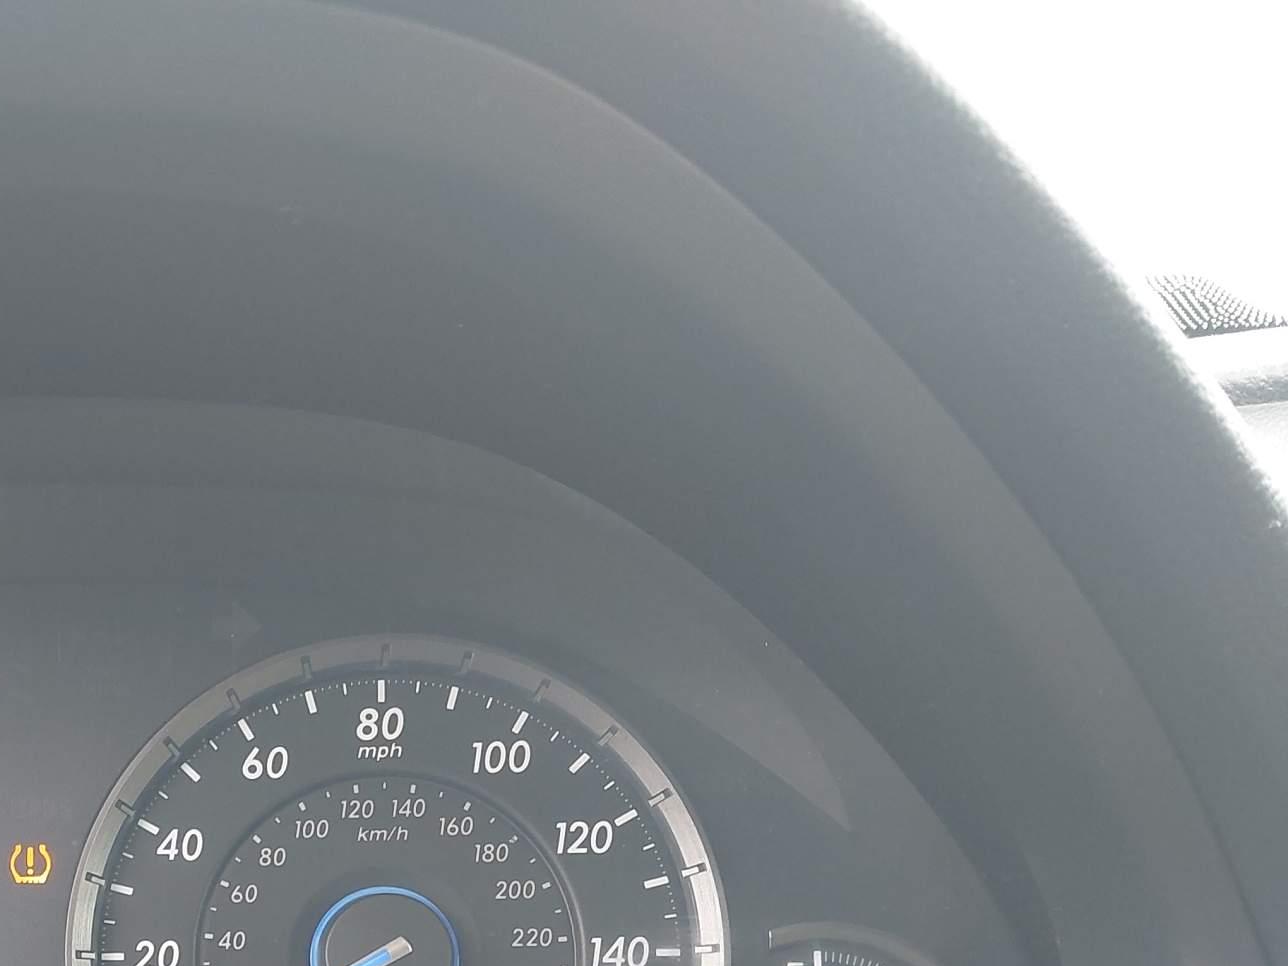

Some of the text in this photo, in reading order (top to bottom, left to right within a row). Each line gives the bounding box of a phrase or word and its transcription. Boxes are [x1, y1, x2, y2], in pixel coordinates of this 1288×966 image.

[356, 708, 404, 742] 80
[358, 743, 402, 761] mph
[472, 740, 531, 774] 100
[242, 746, 289, 779] 60
[340, 799, 374, 818] 120
[391, 798, 426, 818] 140
[294, 820, 329, 839] 100
[357, 823, 409, 842] km/h
[438, 817, 474, 837] 160
[157, 827, 203, 861] 40
[555, 820, 613, 855] 120
[259, 847, 286, 867] 80
[473, 843, 509, 862] 180
[231, 884, 258, 903] 60
[495, 880, 536, 900] 200
[219, 931, 246, 950] 40
[512, 928, 552, 948] 220
